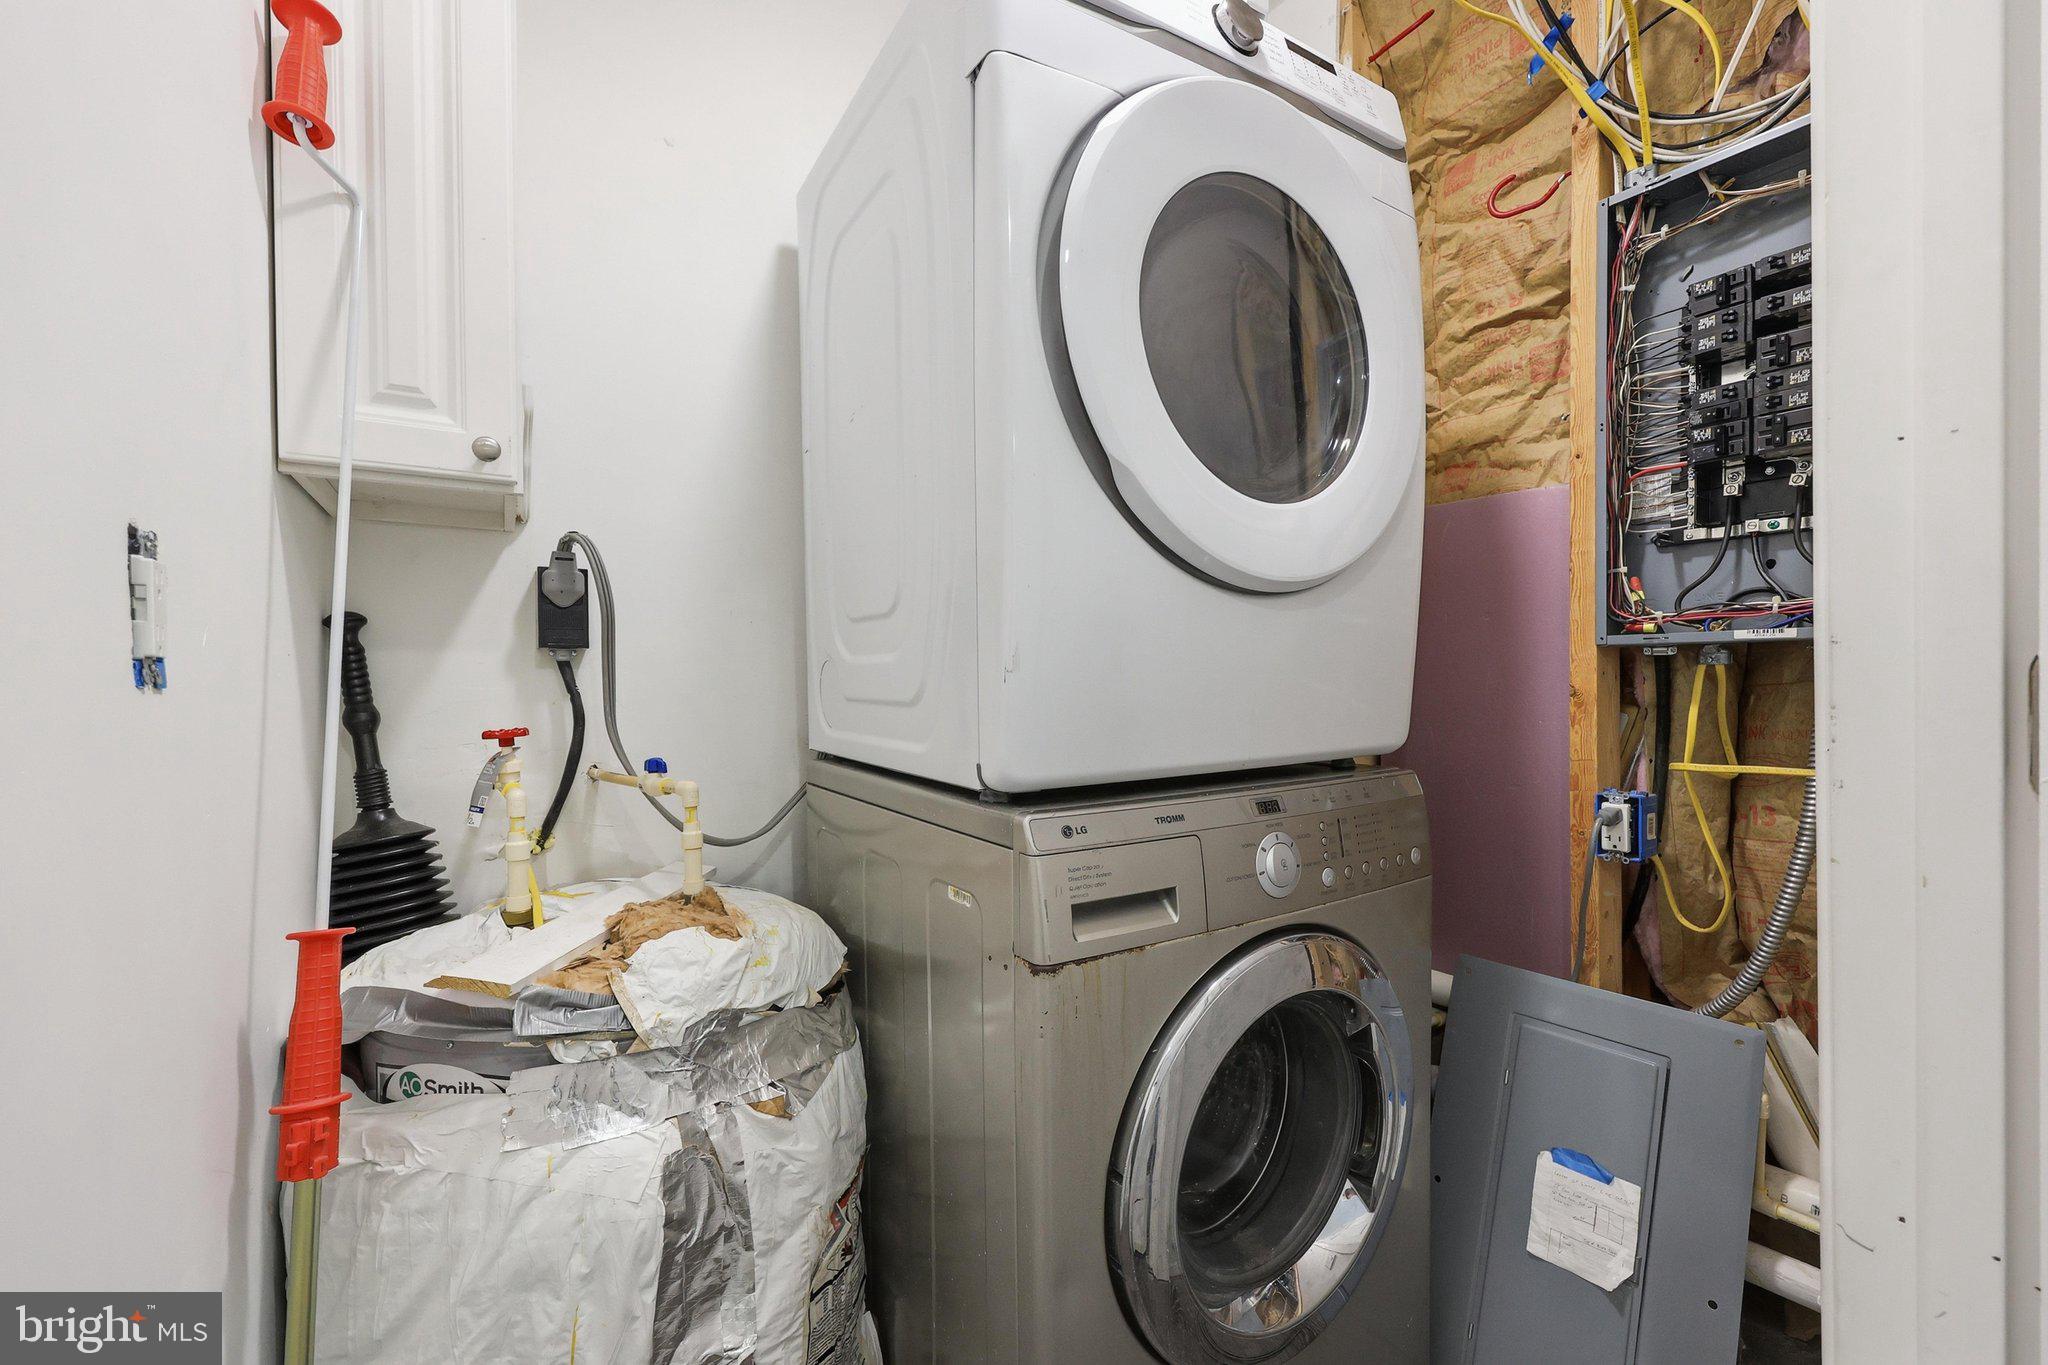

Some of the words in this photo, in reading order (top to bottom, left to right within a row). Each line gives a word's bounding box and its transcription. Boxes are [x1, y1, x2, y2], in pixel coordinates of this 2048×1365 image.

[1154, 814, 1186, 825] TROMM
[1075, 826, 1088, 835] LG
[424, 1078, 484, 1095] Smith
